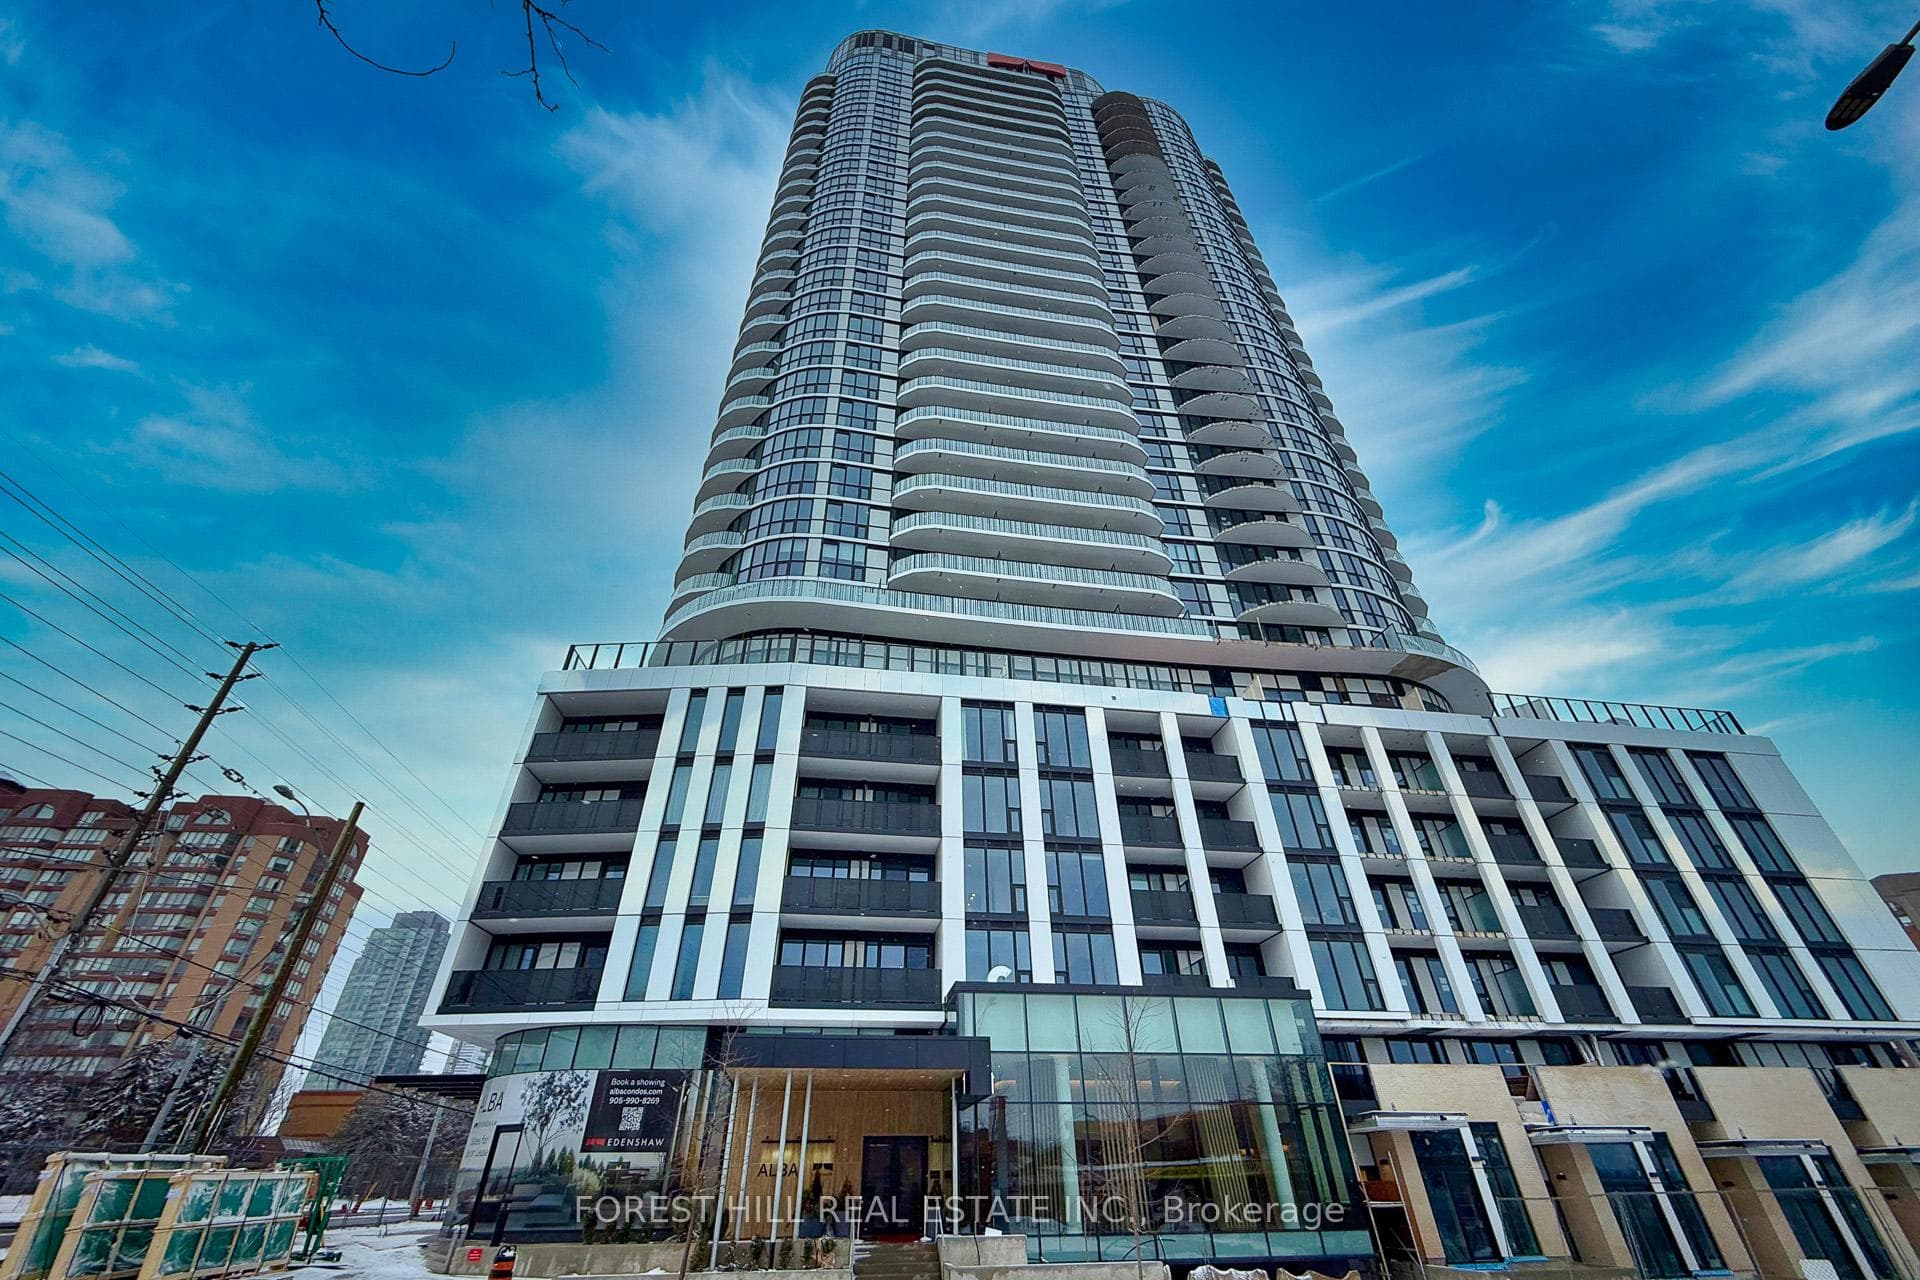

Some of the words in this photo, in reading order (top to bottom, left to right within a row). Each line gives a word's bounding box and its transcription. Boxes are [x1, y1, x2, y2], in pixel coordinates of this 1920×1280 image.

[611, 1078, 629, 1086] Book
[637, 1079, 666, 1088] showing
[607, 1137, 665, 1147] EDENSHAW
